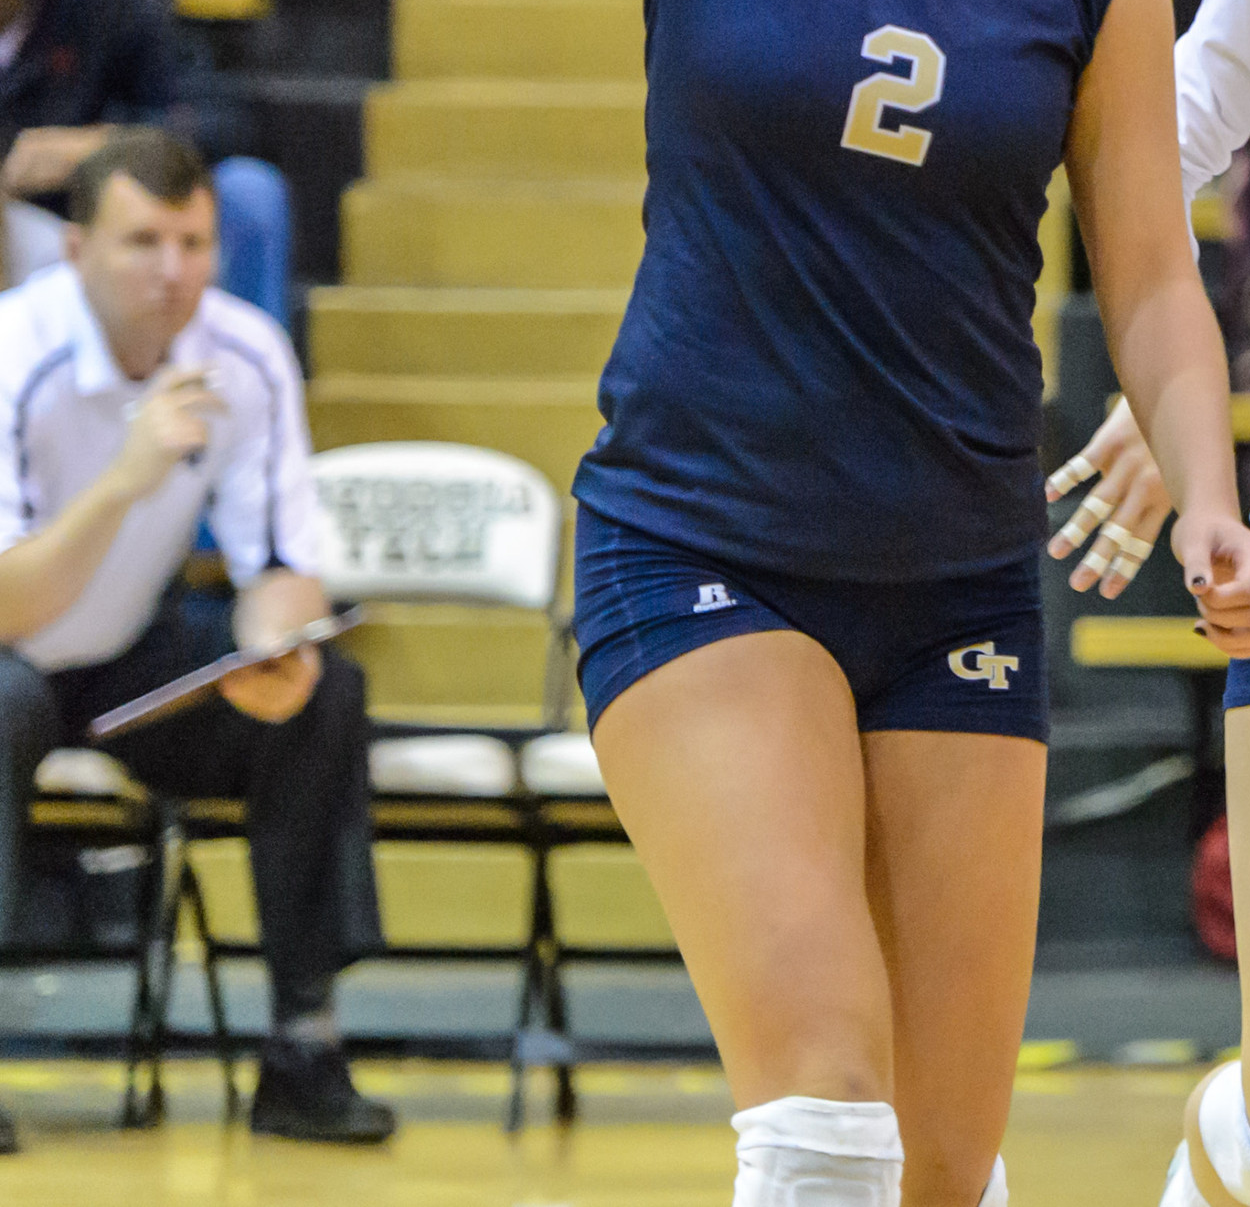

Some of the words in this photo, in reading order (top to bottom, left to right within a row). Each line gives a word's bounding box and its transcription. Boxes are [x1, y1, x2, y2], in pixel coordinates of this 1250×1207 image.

[840, 24, 946, 167] 2
[698, 583, 729, 604] R
[948, 641, 1019, 689] GT
